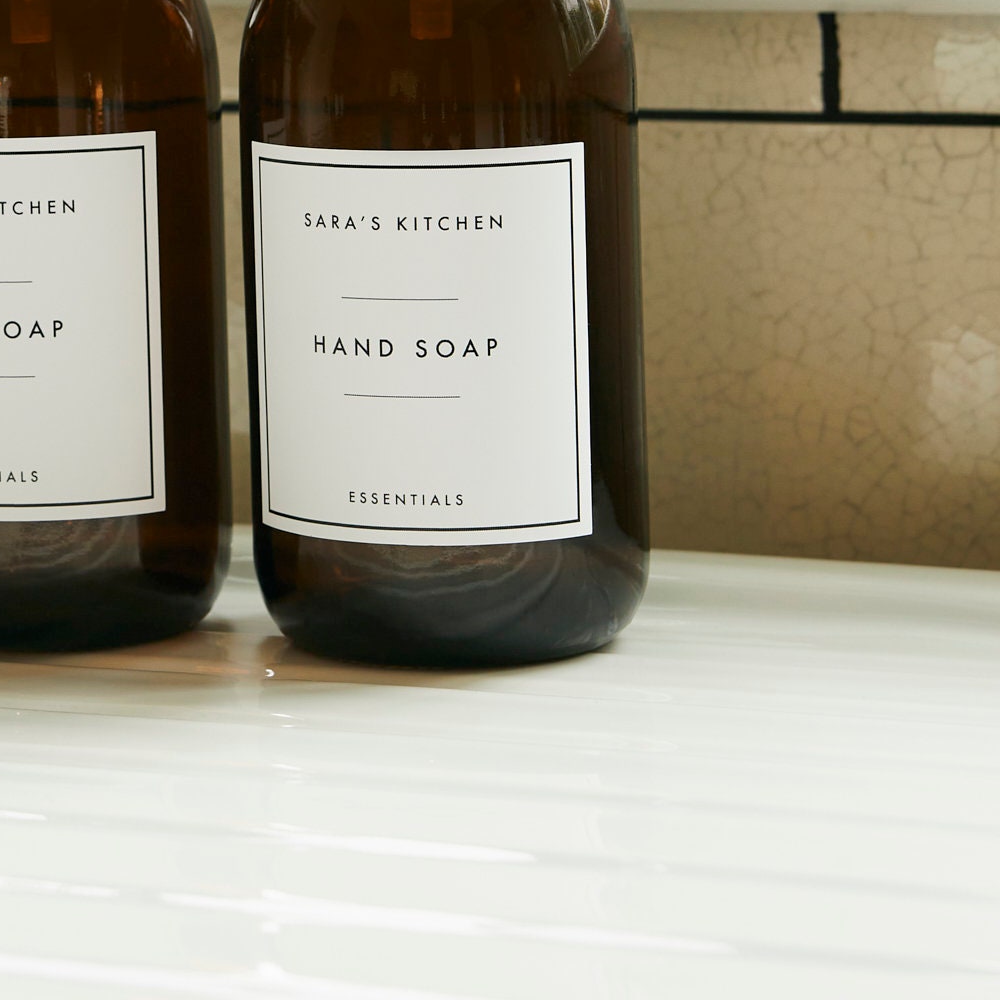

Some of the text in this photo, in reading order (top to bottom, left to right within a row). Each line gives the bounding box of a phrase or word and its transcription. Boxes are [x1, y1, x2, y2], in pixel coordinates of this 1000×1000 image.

[304, 212, 504, 232] SARA'S KITCHEN
[313, 334, 499, 359] HAND SOAP
[348, 490, 464, 506] ESSENTIALS
